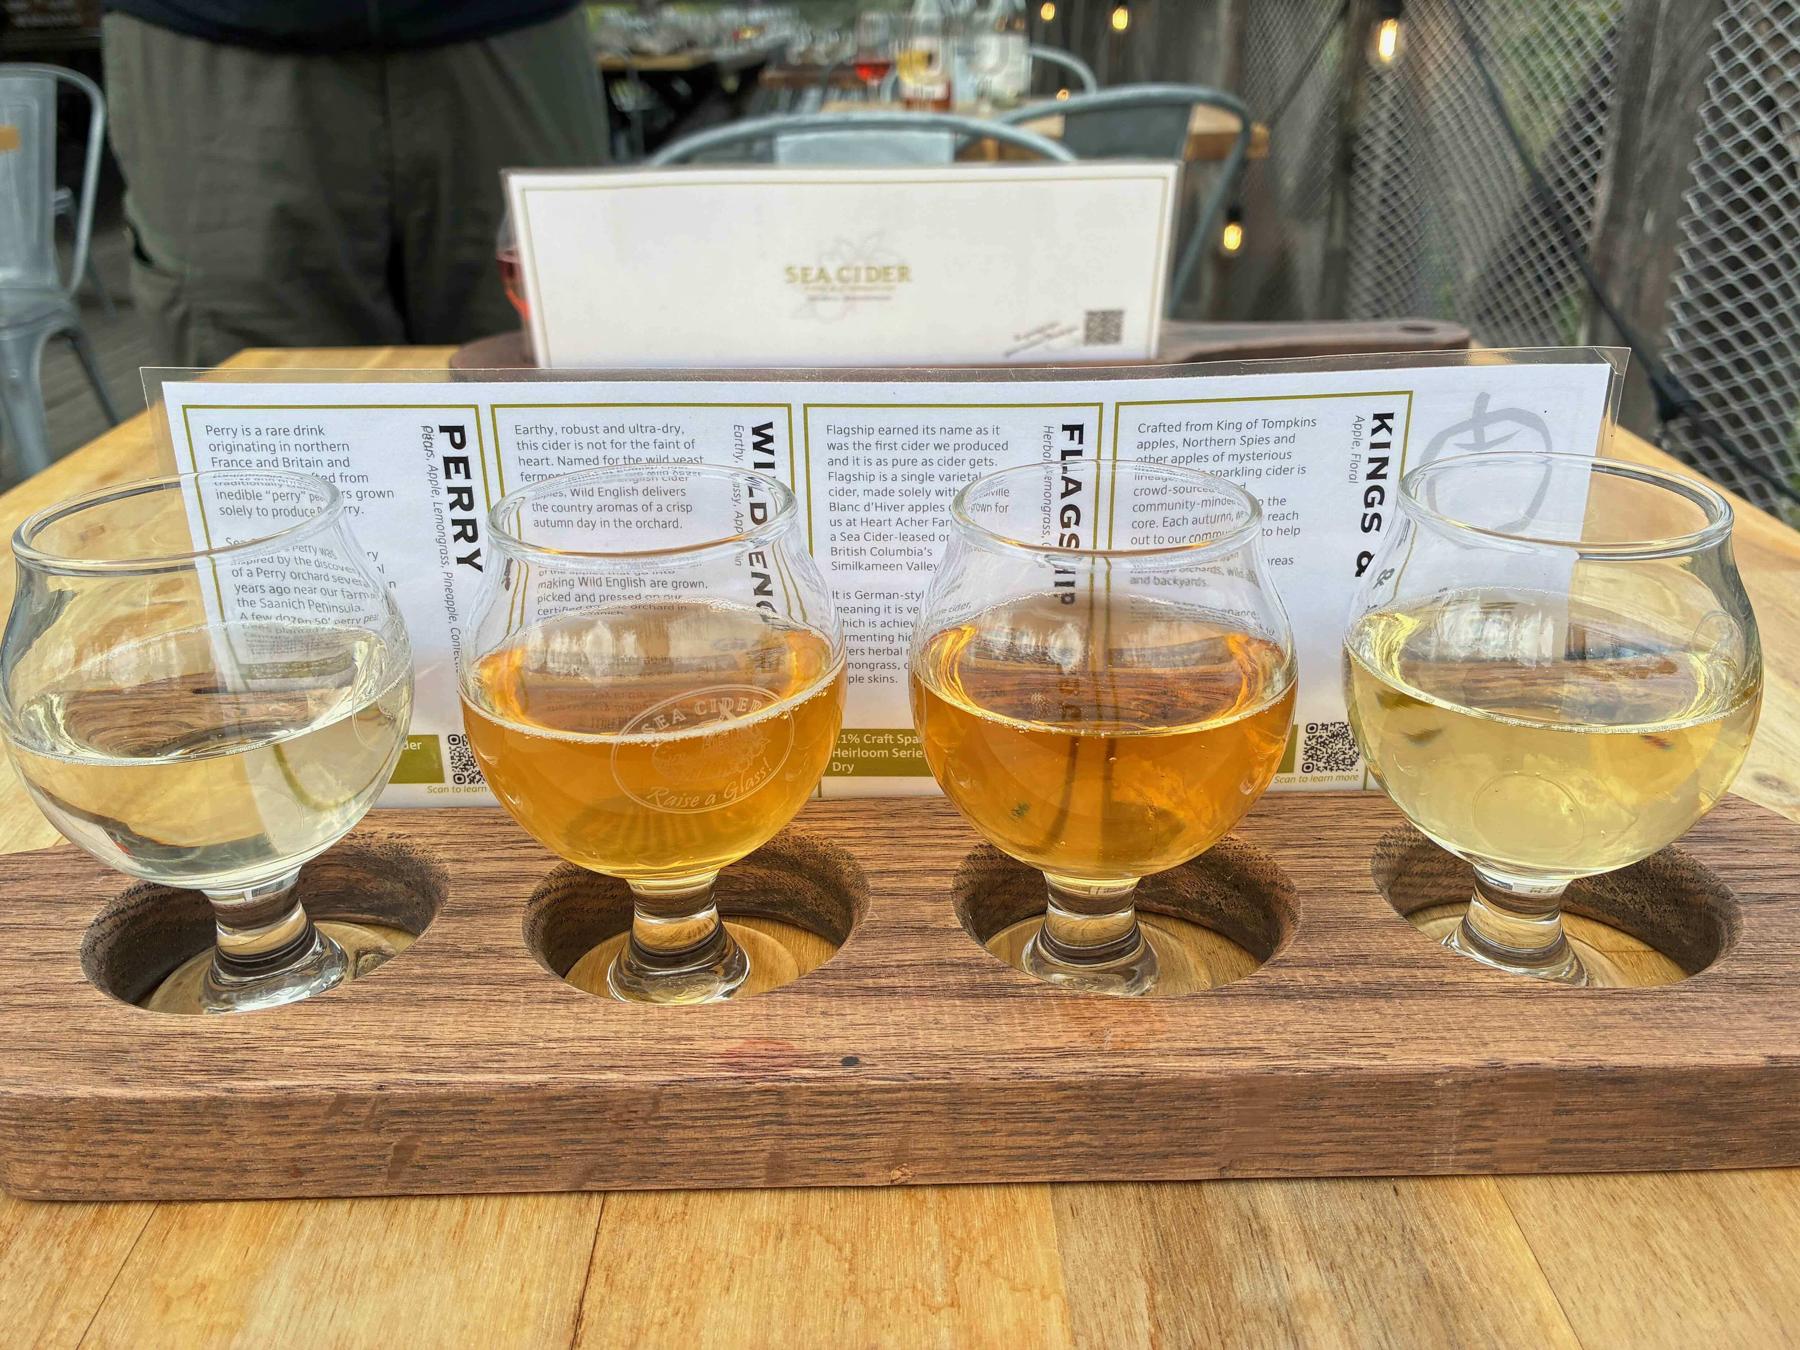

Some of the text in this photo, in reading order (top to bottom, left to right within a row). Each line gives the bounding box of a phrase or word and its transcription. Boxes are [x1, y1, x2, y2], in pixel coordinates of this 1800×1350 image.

[785, 266, 912, 283] SEA CIDER
[515, 424, 685, 436] Earthy, robust and ultra-dry,
[826, 425, 972, 437] Flagship earned its name
[1138, 417, 1316, 433] Crafted from King of Tompkins
[205, 425, 325, 438] Perry rare drink
[209, 442, 350, 454] originating northern
[517, 439, 680, 450] this cider not for the faint
[732, 424, 745, 464] Earthy,
[827, 441, 1009, 452] was the first cider produced
[1137, 434, 1295, 450] apples, Northern Spies and
[1348, 415, 1366, 484] Apple, Floral
[211, 457, 350, 468] France and Britain and
[518, 456, 554, 466] heart.
[557, 456, 599, 466] Named
[603, 455, 619, 465] for
[624, 455, 641, 465] the
[646, 455, 669, 464] wild
[828, 456, 997, 468] and pure cider gets.
[1171, 452, 1209, 465] apples
[1213, 452, 1225, 462] of
[1228, 450, 1292, 463] mysterious
[1266, 465, 1294, 476] cider
[1298, 465, 1306, 474] is
[1360, 412, 1395, 533] KINGS
[340, 473, 368, 483] from
[828, 472, 982, 484] Flagship single varietal
[216, 490, 262, 500] inedible
[356, 489, 394, 503] grown
[438, 424, 484, 573] PERRY
[570, 486, 686, 499] Wild English delivers
[829, 488, 860, 498] cider,
[863, 488, 894, 496] made
[898, 488, 932, 499] solely
[1268, 496, 1286, 506] the
[220, 506, 315, 519] solely produce
[532, 502, 693, 514] the country aromas crisp
[829, 502, 1009, 514] Blanc d'Hiver apples for
[534, 518, 682, 531] autumn day the orchard.
[861, 517, 929, 527] Heart Acher
[1132, 519, 1158, 529] core.
[1162, 517, 1188, 528] Each
[1268, 512, 1299, 521] reach
[840, 532, 860, 541] Sea
[864, 532, 935, 541] Cider-leased
[1131, 525, 1300, 544] out to our help
[427, 464, 458, 623] Apple, Lemongrass, Pineapple,
[831, 547, 932, 556] British Columbia's
[295, 557, 312, 566] the
[832, 562, 938, 573] Similkameen Valley
[257, 568, 329, 582] Perry orchard
[1131, 576, 1151, 585] and
[538, 577, 708, 590] making Wild English are grown,
[234, 584, 265, 596] years
[269, 586, 290, 596] ago
[294, 586, 317, 595] near
[341, 589, 370, 599] farm
[855, 591, 925, 601] German-styl
[537, 592, 641, 604] picked and pressed
[237, 599, 364, 613] the Saanich Peninsula.
[869, 620, 876, 628] is
[869, 648, 902, 656] herbal
[868, 674, 898, 683] skins.
[642, 698, 762, 734] SEA CIDER
[864, 734, 894, 744] Craft
[832, 748, 888, 758] Heirloom
[832, 762, 854, 773] Dry
[648, 757, 771, 808] Raise Glass!
[1274, 775, 1295, 784] Scan
[1299, 775, 1307, 783] to
[1310, 774, 1332, 782] learn
[427, 786, 449, 794] Scan
